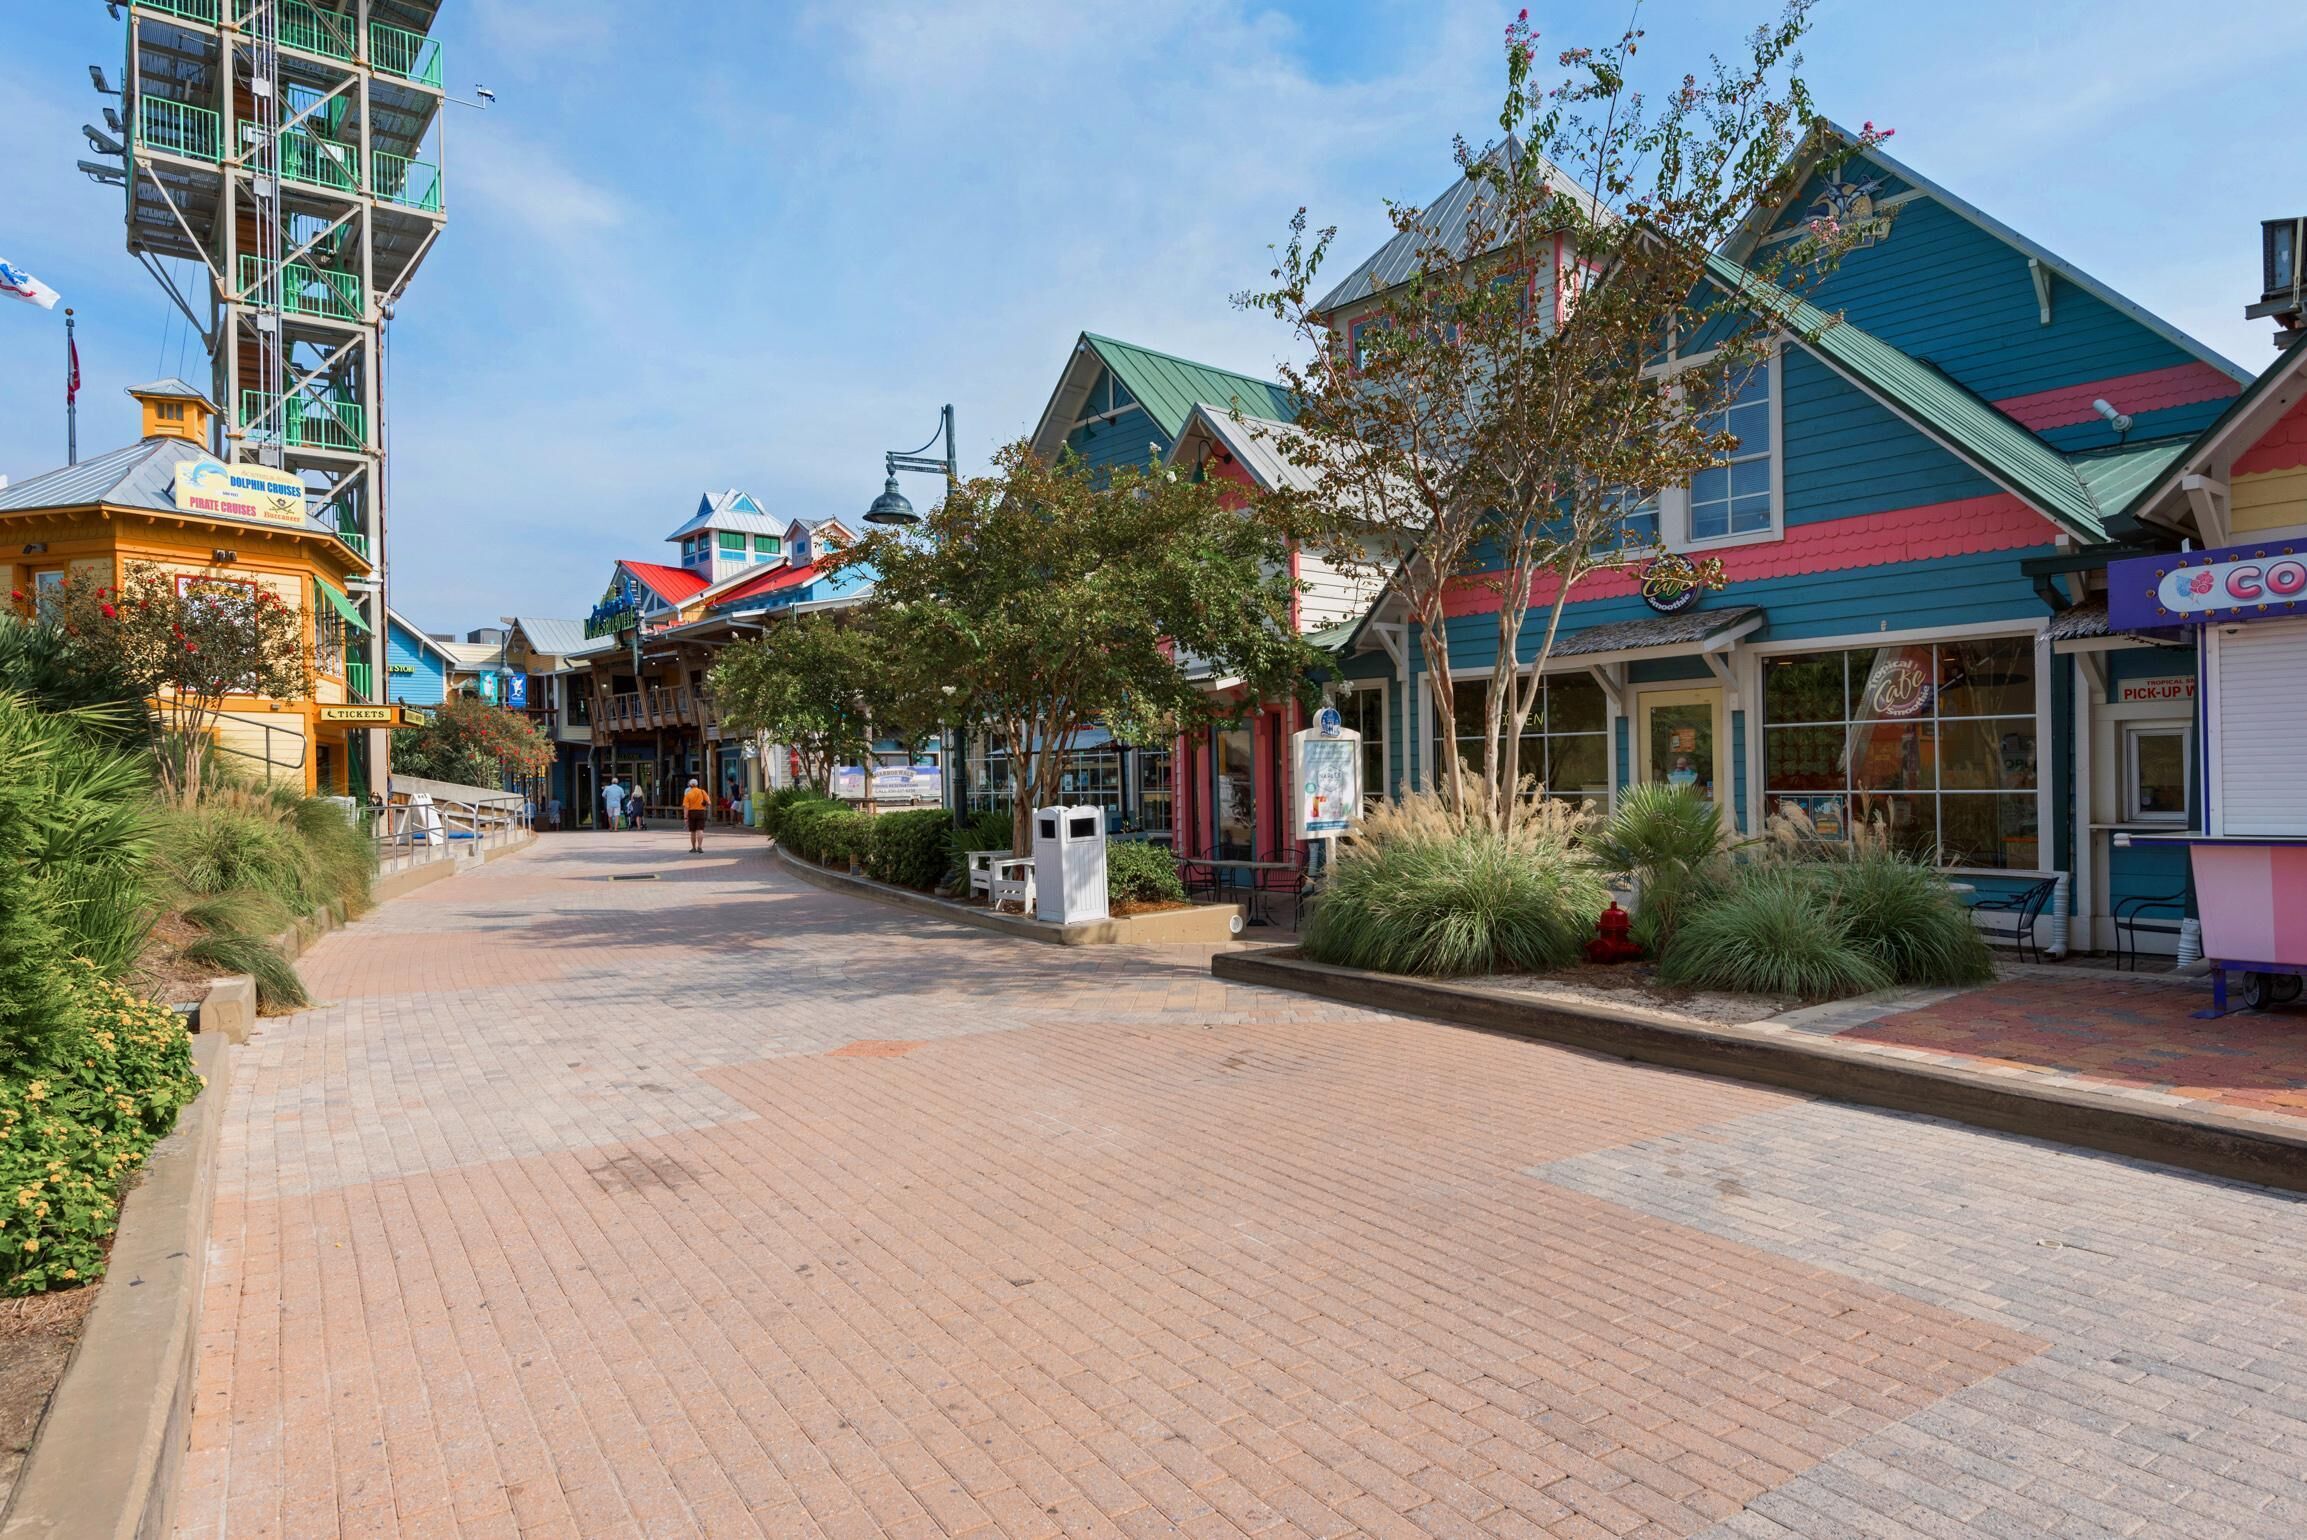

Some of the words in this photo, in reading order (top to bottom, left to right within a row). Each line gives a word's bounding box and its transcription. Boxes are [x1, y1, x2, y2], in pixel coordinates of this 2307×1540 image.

[230, 475, 266, 492] DOLPHIN
[267, 482, 301, 498] CRUISES
[189, 496, 219, 511] PIRATE
[220, 501, 257, 517] CRUISES
[2146, 678, 2184, 687] TROPICAL
[2124, 686, 2181, 701] PICK-UP
[337, 710, 385, 719] TICKETS
